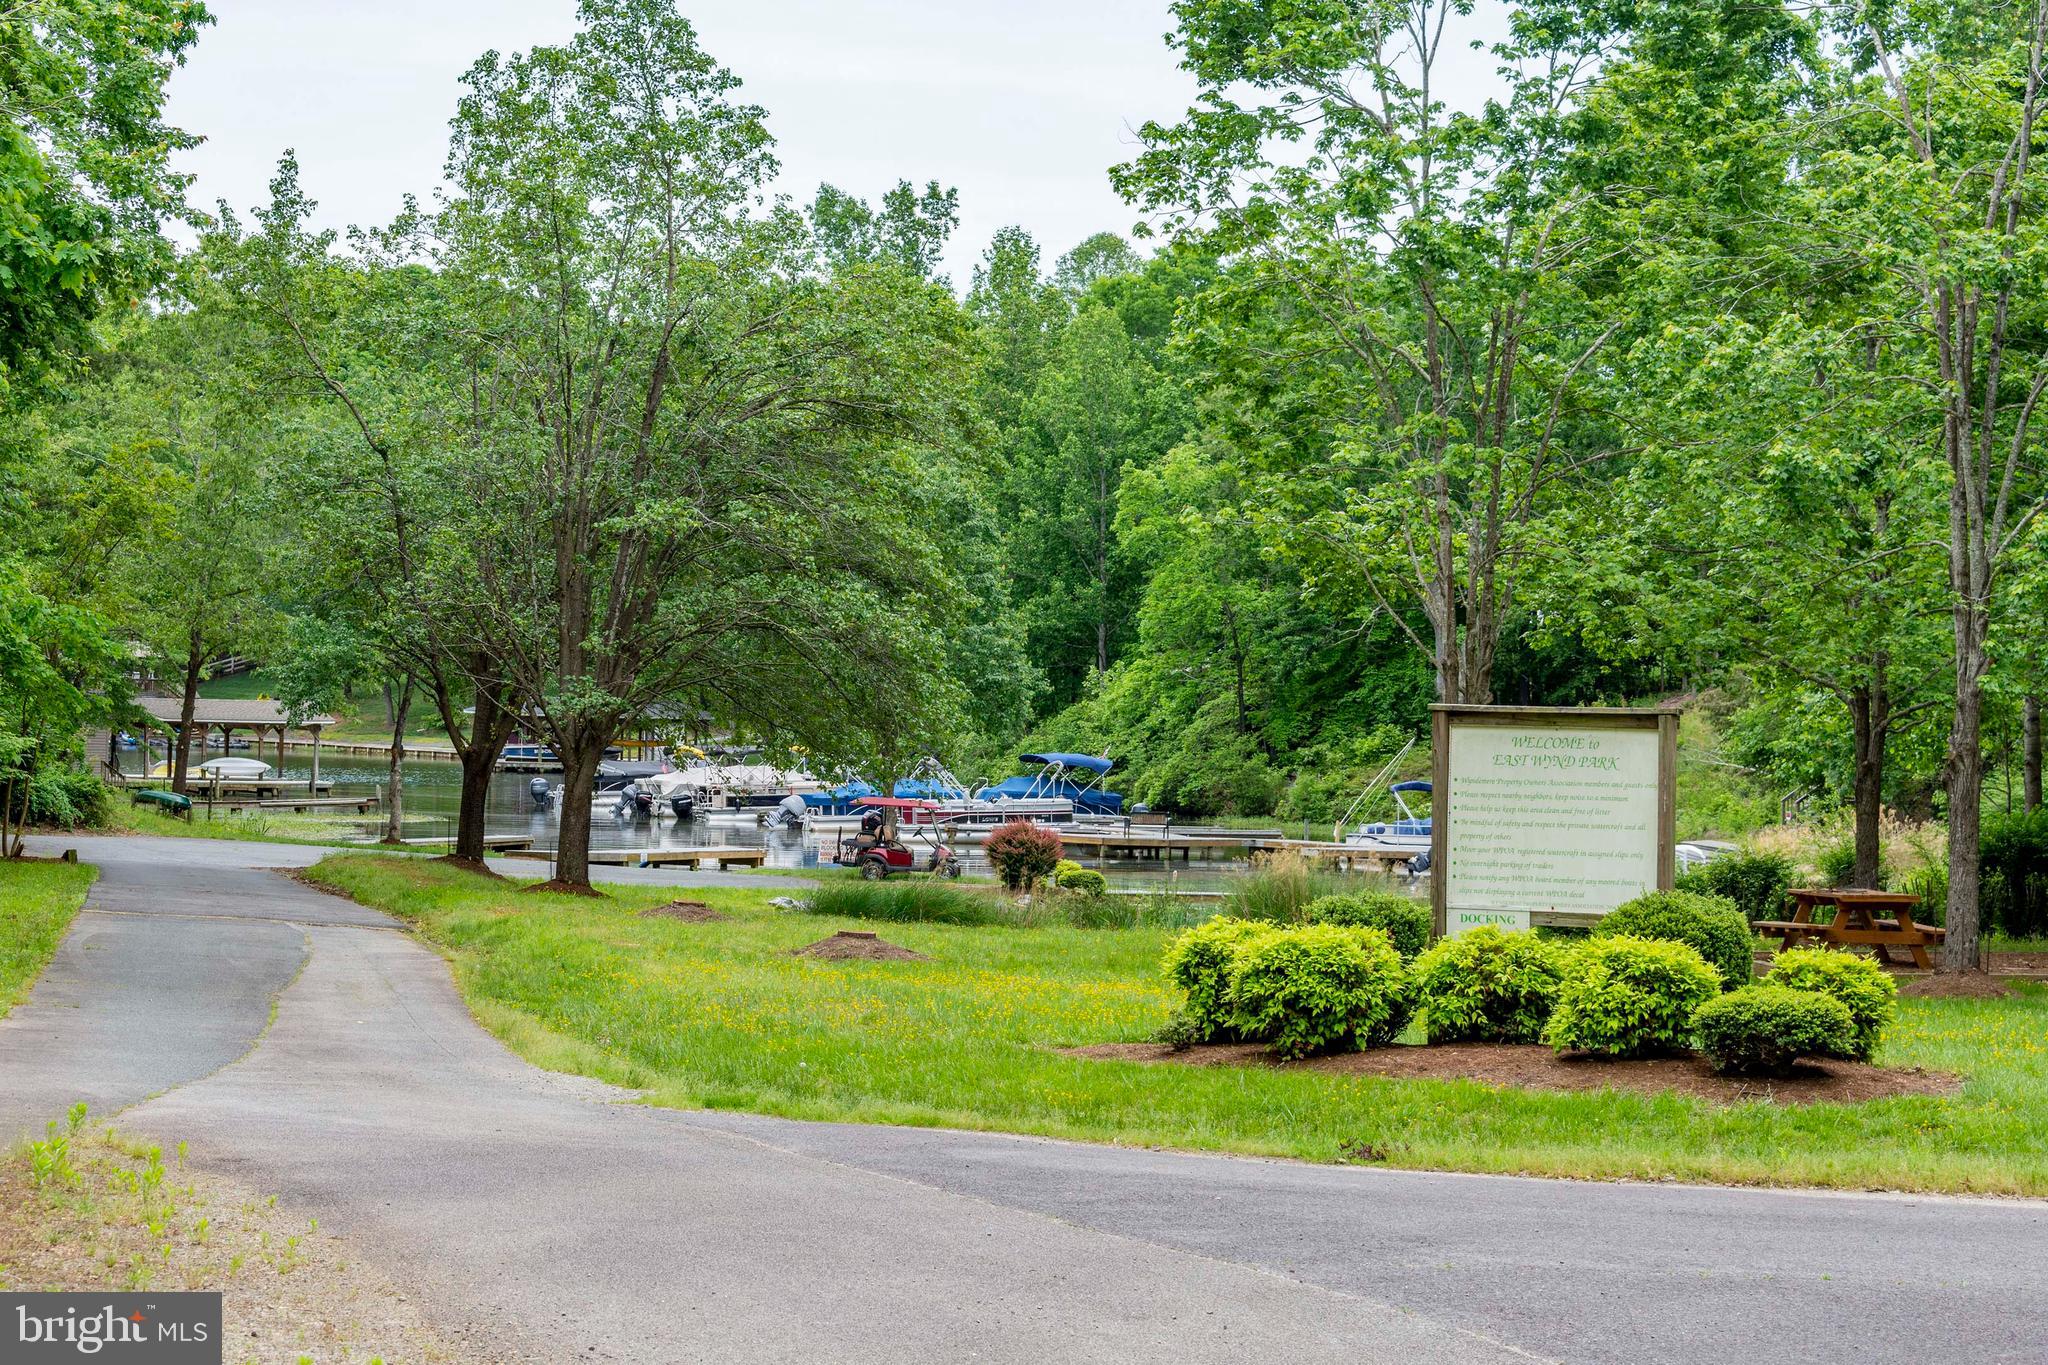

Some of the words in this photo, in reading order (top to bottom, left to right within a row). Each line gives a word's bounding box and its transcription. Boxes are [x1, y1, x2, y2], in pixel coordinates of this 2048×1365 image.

[1511, 735, 1585, 749] WELCOME
[1588, 738, 1600, 749] to
[1492, 754, 1530, 767] EAST
[1531, 754, 1575, 770] WYND
[1578, 756, 1620, 770] PARK
[1461, 914, 1516, 924] DOCKING
